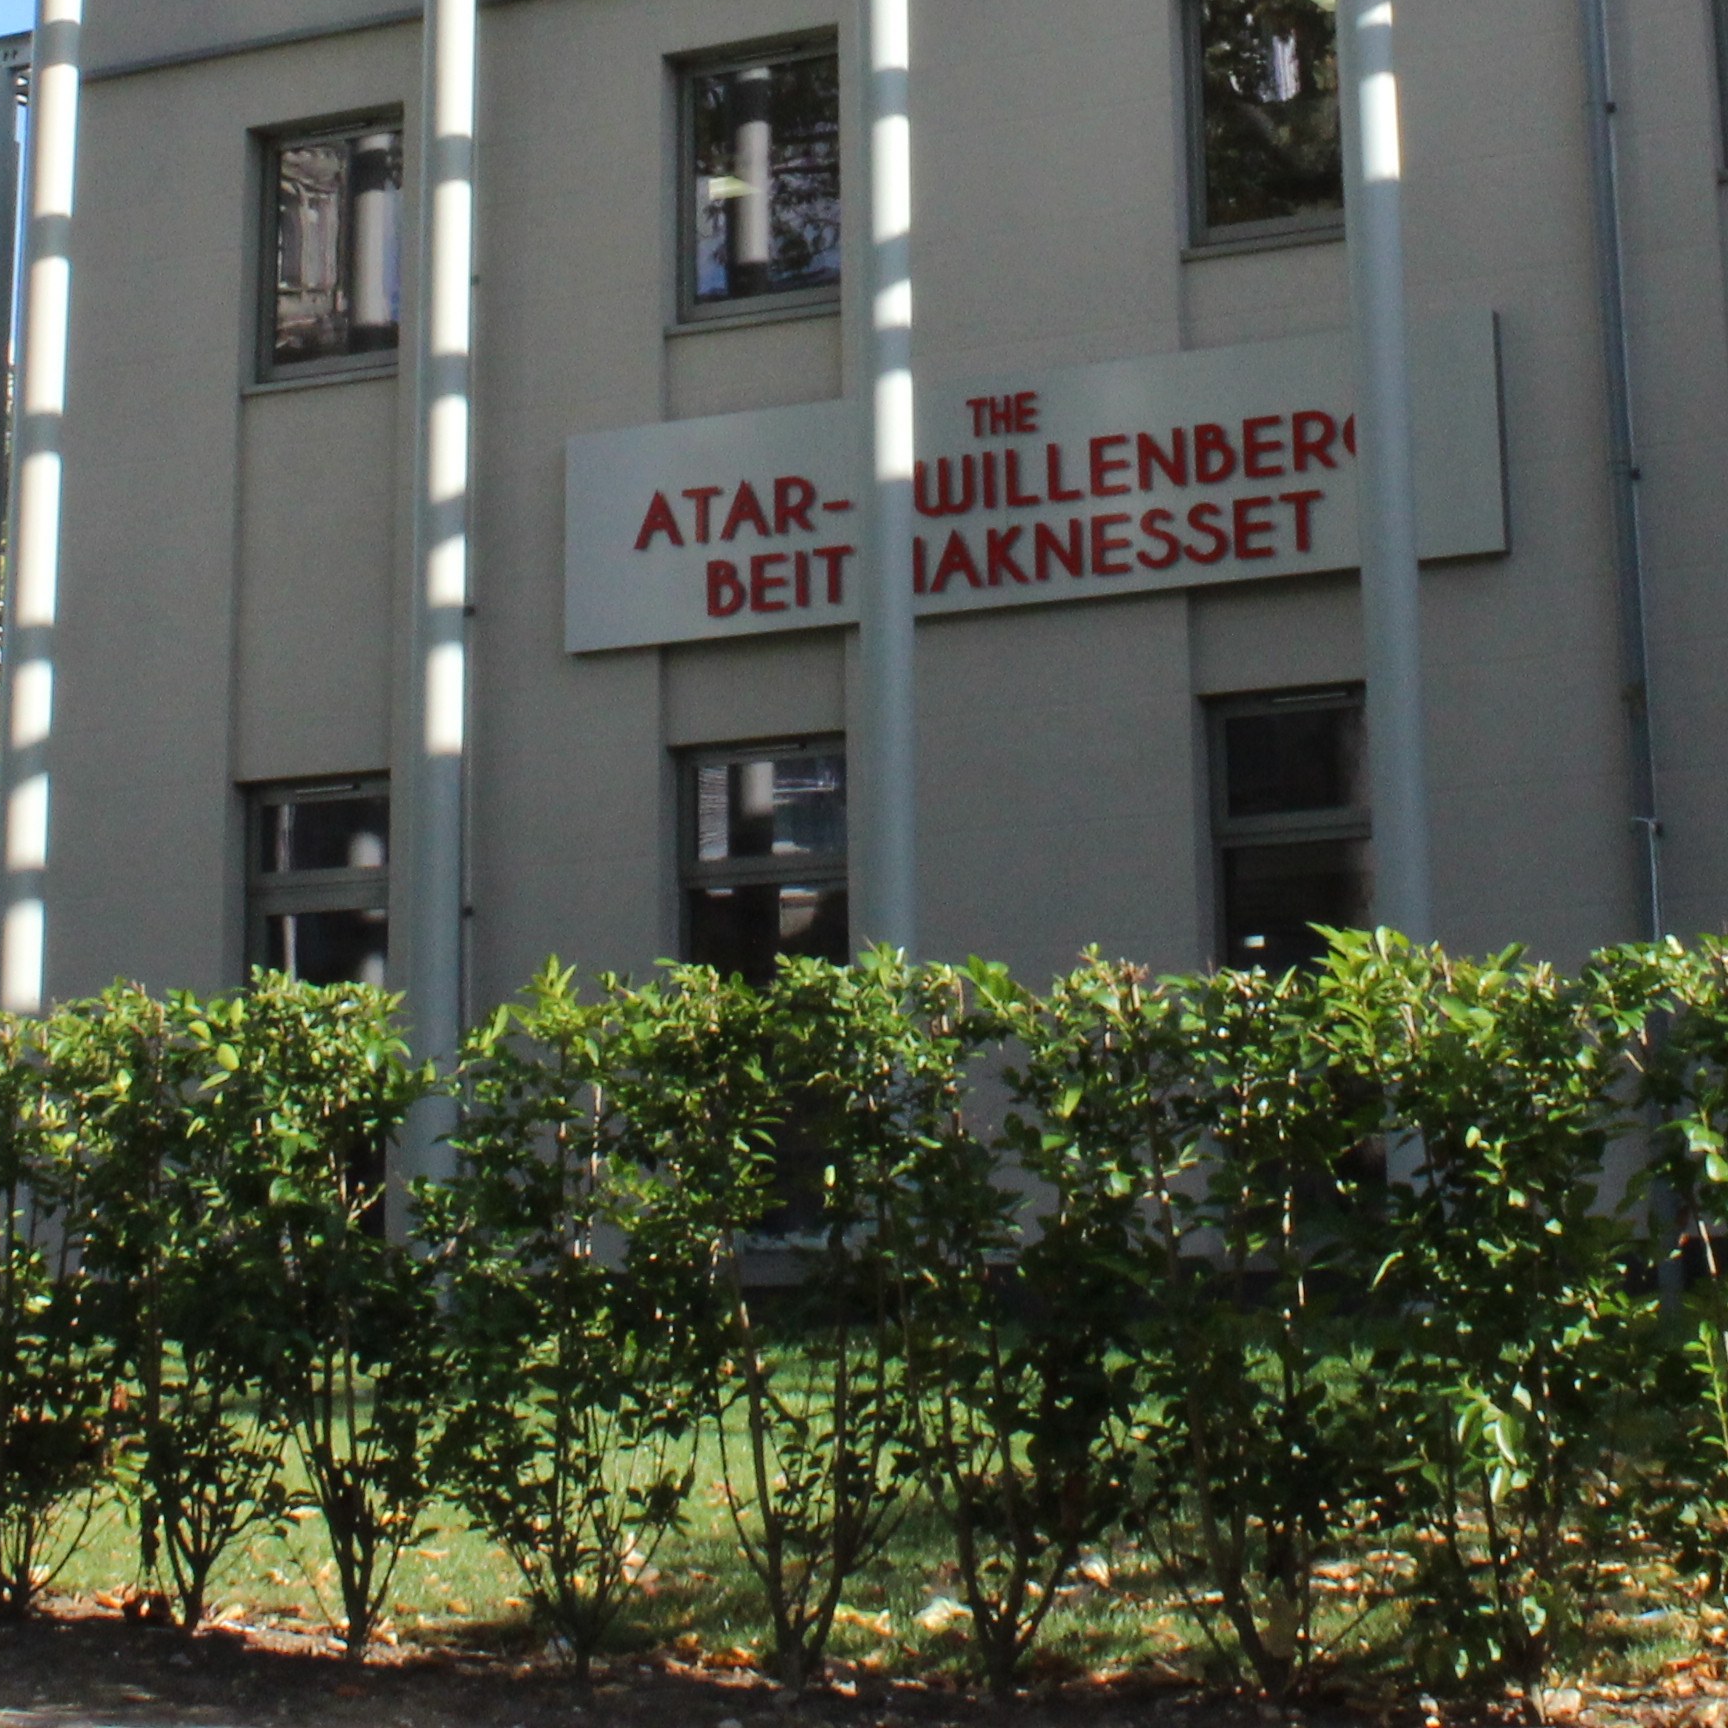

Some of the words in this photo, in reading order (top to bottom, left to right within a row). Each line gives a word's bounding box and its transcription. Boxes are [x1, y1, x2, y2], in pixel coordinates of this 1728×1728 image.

[967, 392, 1037, 438] THE
[707, 546, 853, 617] BEIT
[912, 491, 1321, 593] AKNESSET
